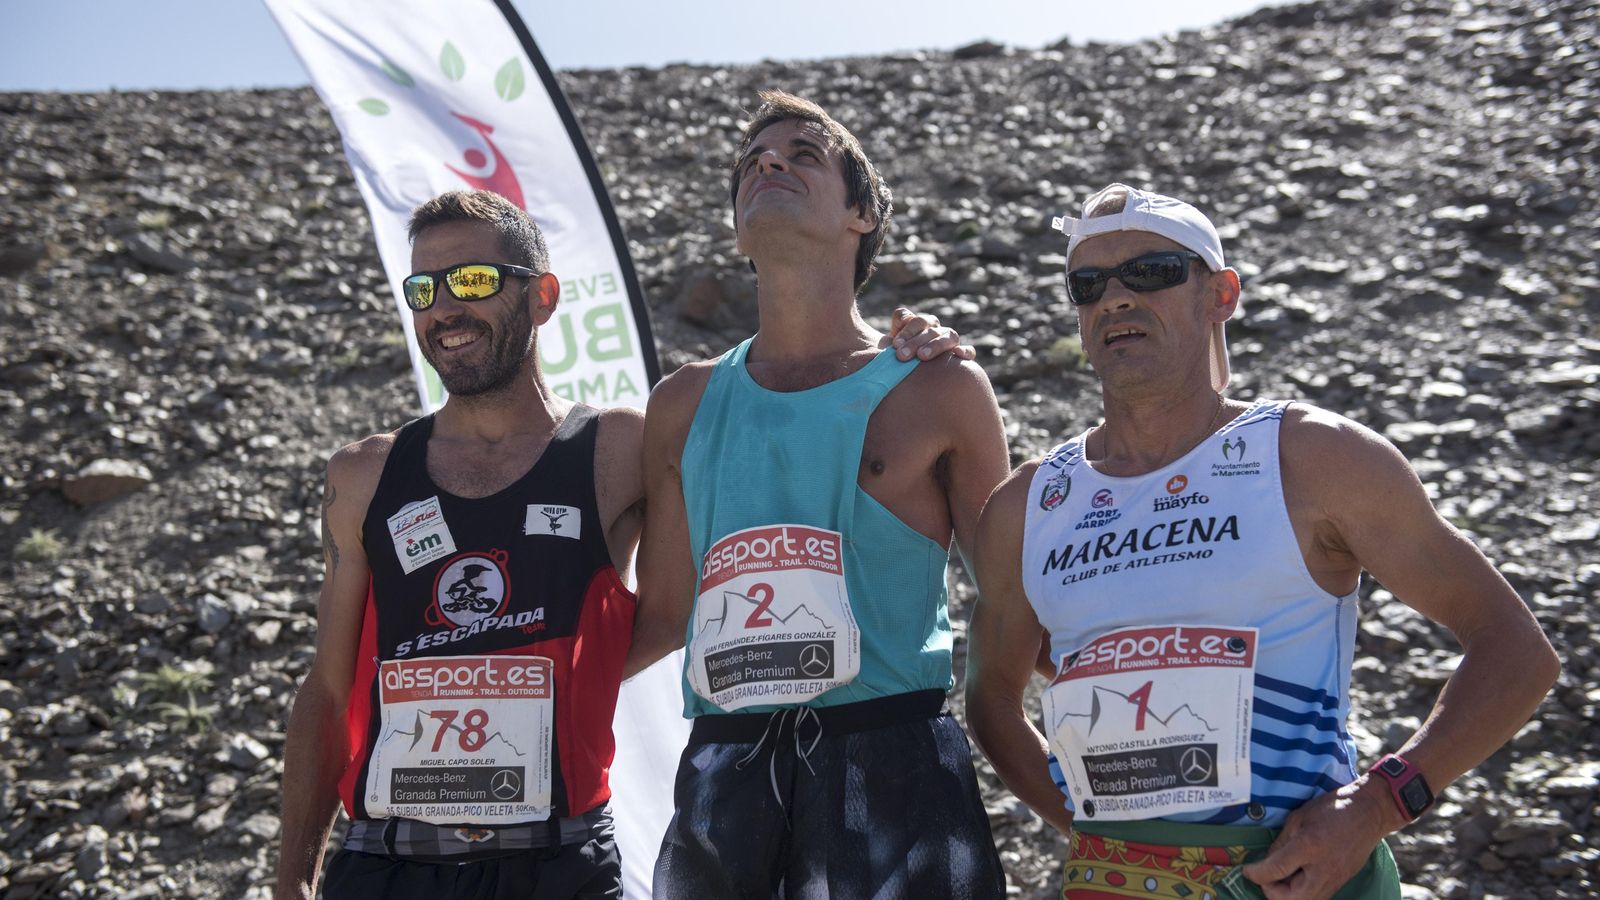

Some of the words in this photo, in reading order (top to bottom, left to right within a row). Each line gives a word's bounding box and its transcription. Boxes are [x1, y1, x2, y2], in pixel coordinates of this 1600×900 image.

[1211, 461, 1261, 470] Ayuntamiento
[1219, 469, 1260, 477] Maracena
[1153, 491, 1209, 512] mayfo
[1083, 508, 1119, 521] SPORT
[1041, 514, 1241, 576] MARACENA
[738, 560, 773, 571] RUNNING
[779, 558, 803, 567] TRAIL
[808, 559, 838, 571] OUTDOOR
[1061, 567, 1098, 586] CLUB
[1102, 562, 1121, 575] DE
[1124, 549, 1214, 570] ATLETISMO
[744, 582, 775, 629] 2
[793, 630, 837, 640] GONZÁLEZ
[708, 649, 773, 672] Mercedes-Benz
[1120, 658, 1160, 669] RUNNING
[1166, 656, 1192, 665] TRAIL
[1199, 656, 1245, 665] OUTDOOR
[384, 657, 546, 697] alssport.es
[711, 668, 742, 689] Granada
[744, 664, 796, 680] Premium
[439, 688, 474, 696] RUNNING
[480, 688, 502, 696] TRAIL
[507, 688, 545, 696] OUTDOOR
[716, 690, 735, 706] SUBIDA
[734, 683, 791, 700] GRANADA-PICO
[794, 681, 823, 694] VELETA
[1127, 680, 1154, 732] 1
[430, 708, 490, 753] 78
[1086, 743, 1118, 754] ANTONIO
[1119, 739, 1158, 750] CASTILLA
[1158, 734, 1206, 747] RODRIGUEZ
[420, 758, 447, 766] MIGUEL
[447, 758, 469, 766] CAPO
[470, 758, 496, 766] SOLER
[394, 773, 466, 784] Mercedes-Benz
[1130, 773, 1177, 790] Premium
[394, 789, 437, 801] Granada
[439, 788, 487, 800] Premium
[1172, 789, 1206, 805] VELETA
[386, 806, 395, 817] 35
[396, 805, 423, 817] SUBIDA
[425, 805, 482, 817] GRANADA-PICO
[484, 804, 514, 816] VELETA
